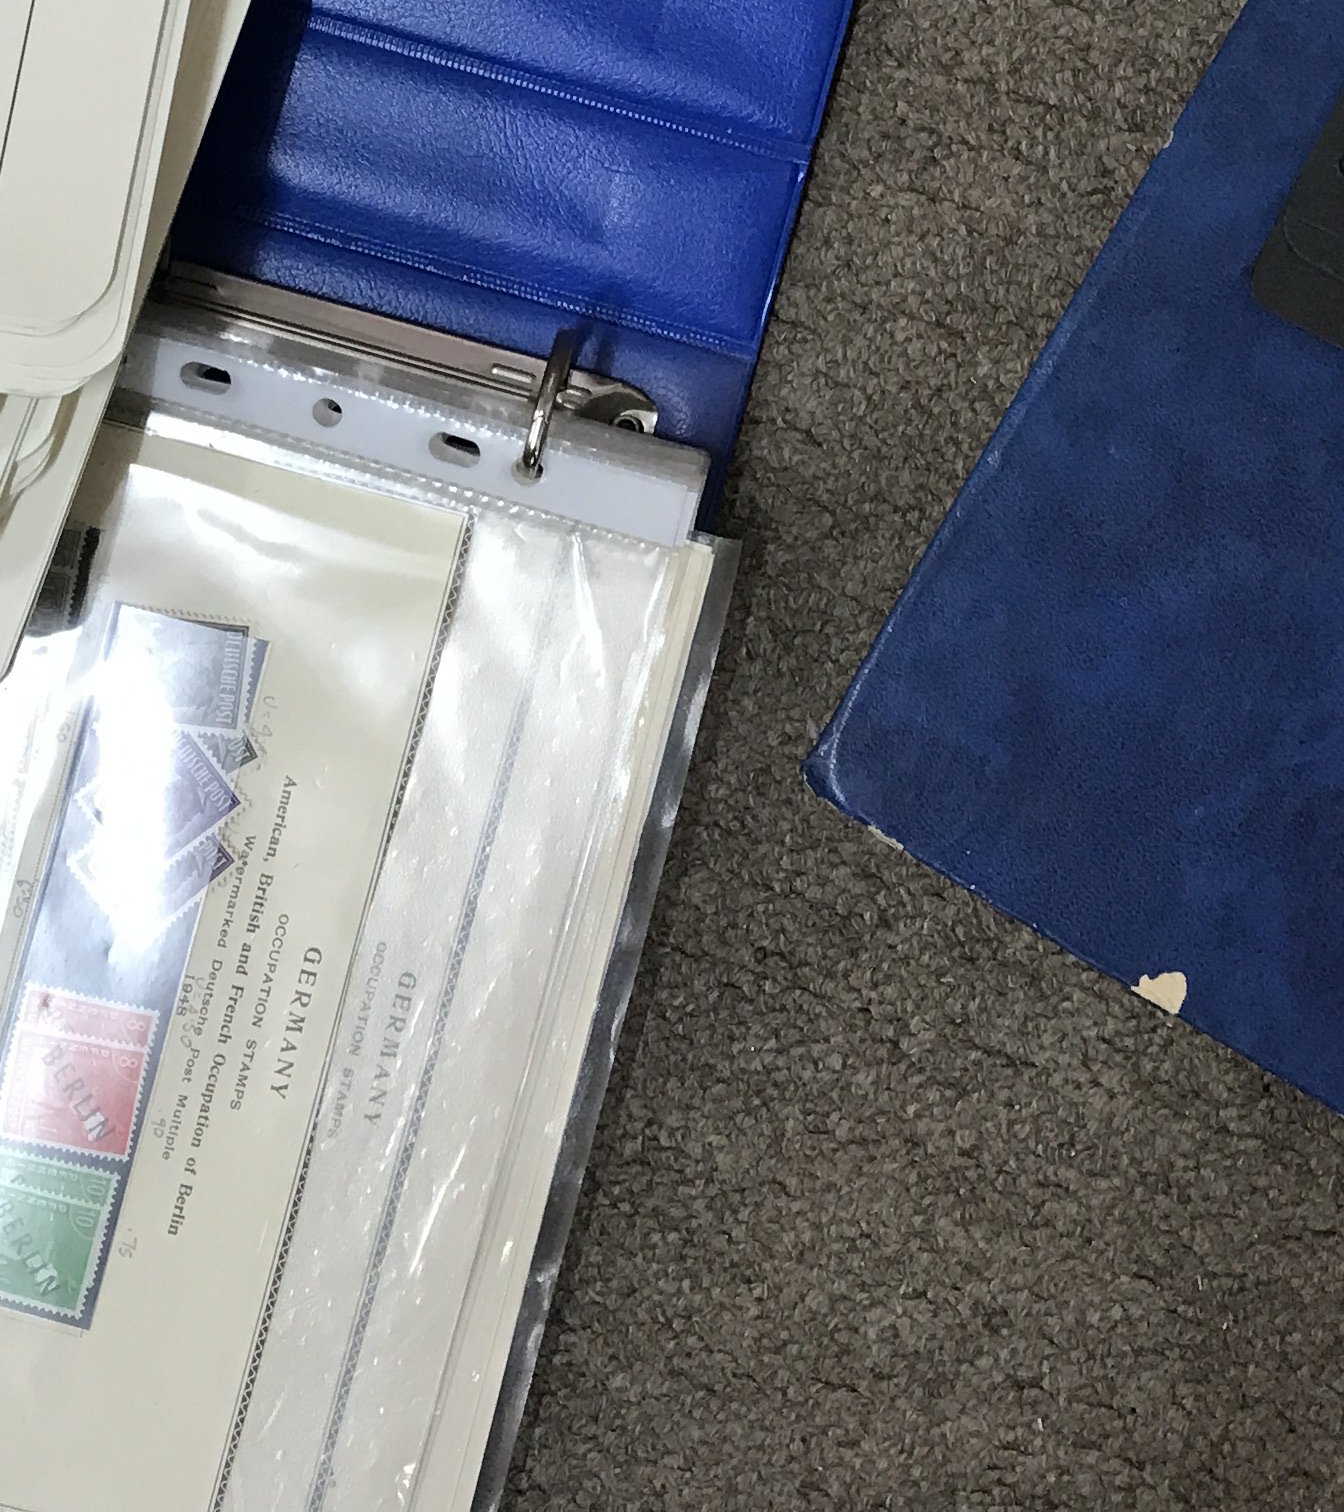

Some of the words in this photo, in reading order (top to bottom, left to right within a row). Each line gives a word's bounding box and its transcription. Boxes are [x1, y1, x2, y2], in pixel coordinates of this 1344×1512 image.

[263, 774, 298, 863] American,
[247, 873, 274, 935] British
[176, 973, 195, 1017] 1948
[236, 942, 253, 977] and
[255, 913, 289, 1029] OCCUPATION
[194, 959, 223, 1037] Deutsche
[218, 984, 244, 1045] French
[270, 946, 323, 1099] GERMANY
[348, 941, 387, 1057] OCCUPATION
[184, 1047, 200, 1084] Post
[230, 1038, 257, 1111] STAMPS
[364, 971, 417, 1126] GERMANY
[41, 1043, 117, 1143] BERLIN
[162, 1094, 189, 1161] Multiple
[190, 1052, 227, 1148] Occupation
[327, 1067, 355, 1139] STAMPS
[184, 1157, 198, 1176] of
[167, 1183, 194, 1236] Berlin
